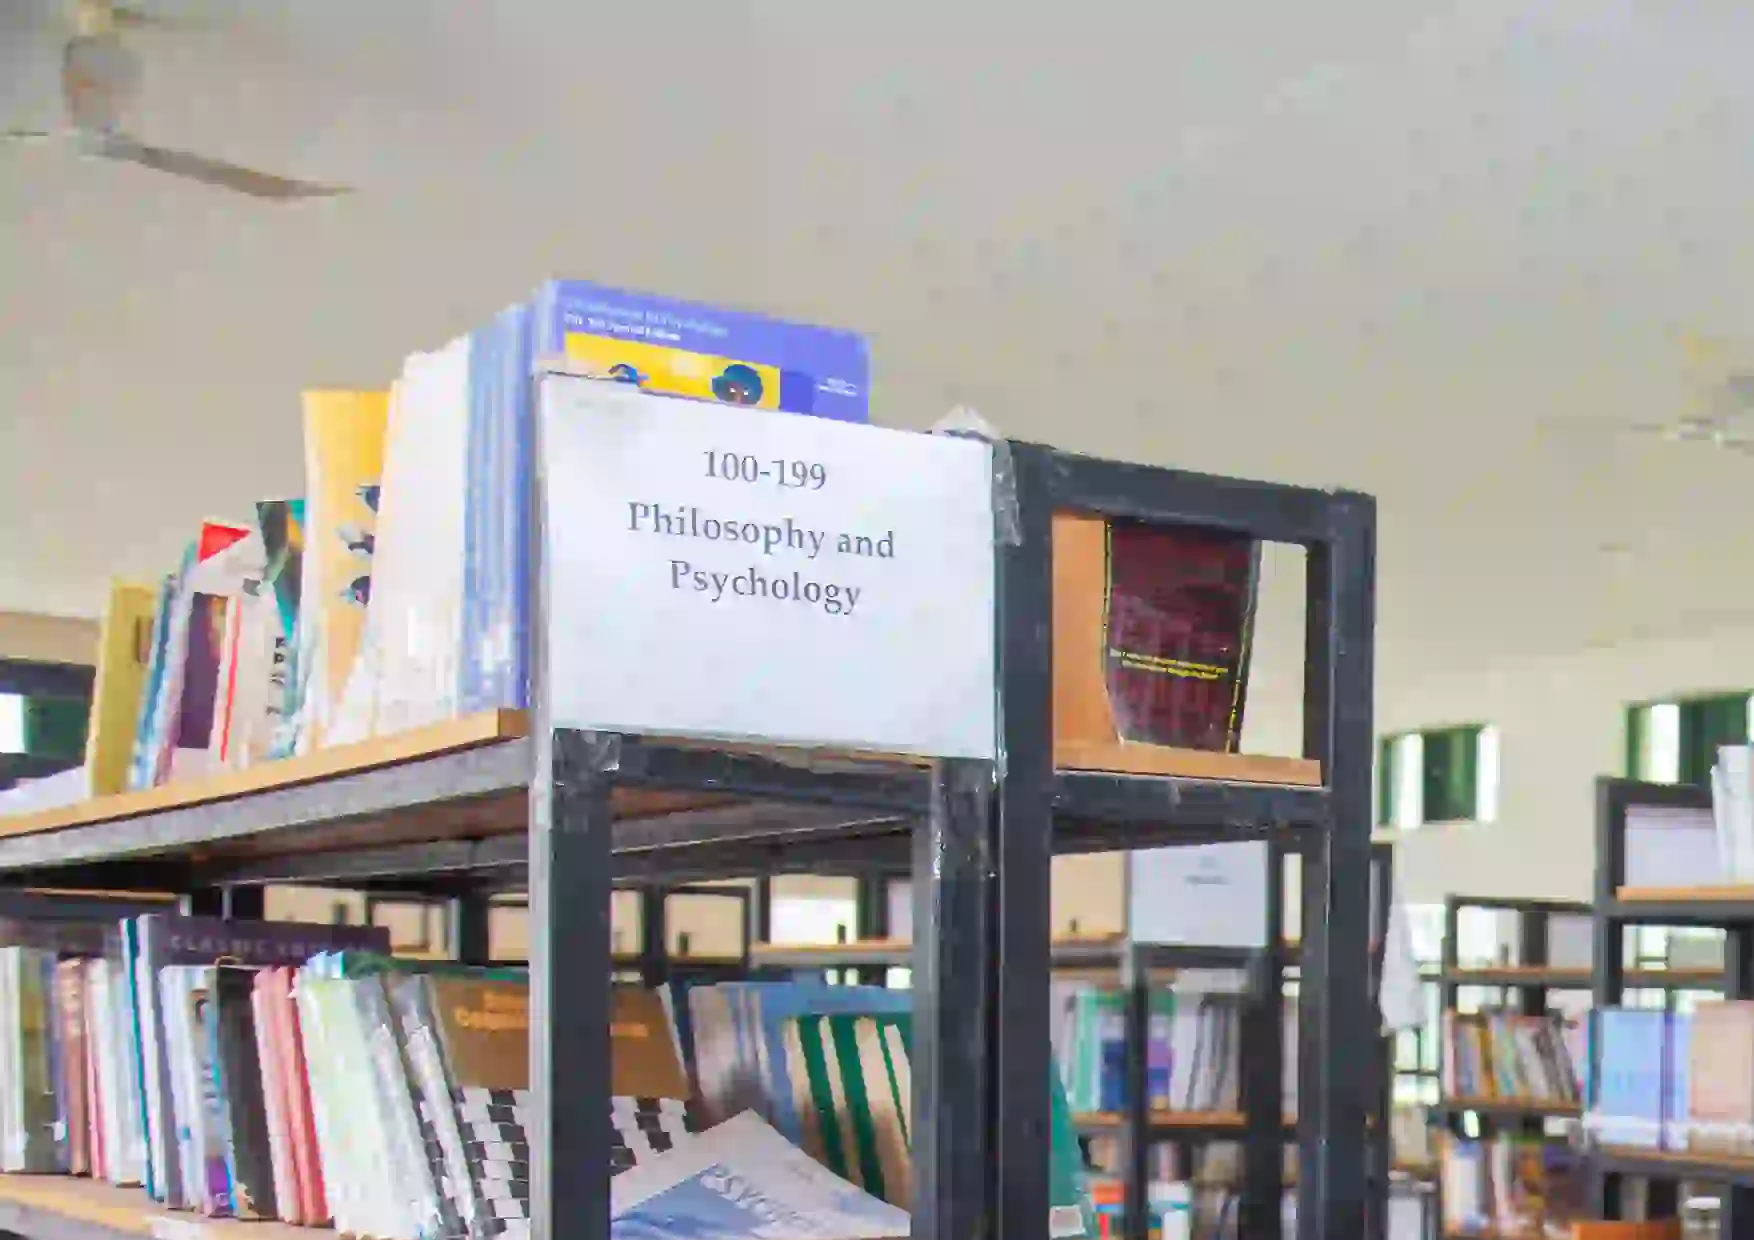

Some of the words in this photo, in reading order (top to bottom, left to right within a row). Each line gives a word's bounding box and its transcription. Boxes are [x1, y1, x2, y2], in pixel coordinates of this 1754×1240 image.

[703, 449, 827, 490] 100-199
[627, 501, 825, 559] Philosophy
[837, 529, 895, 559] and
[667, 559, 861, 615] Psychology
